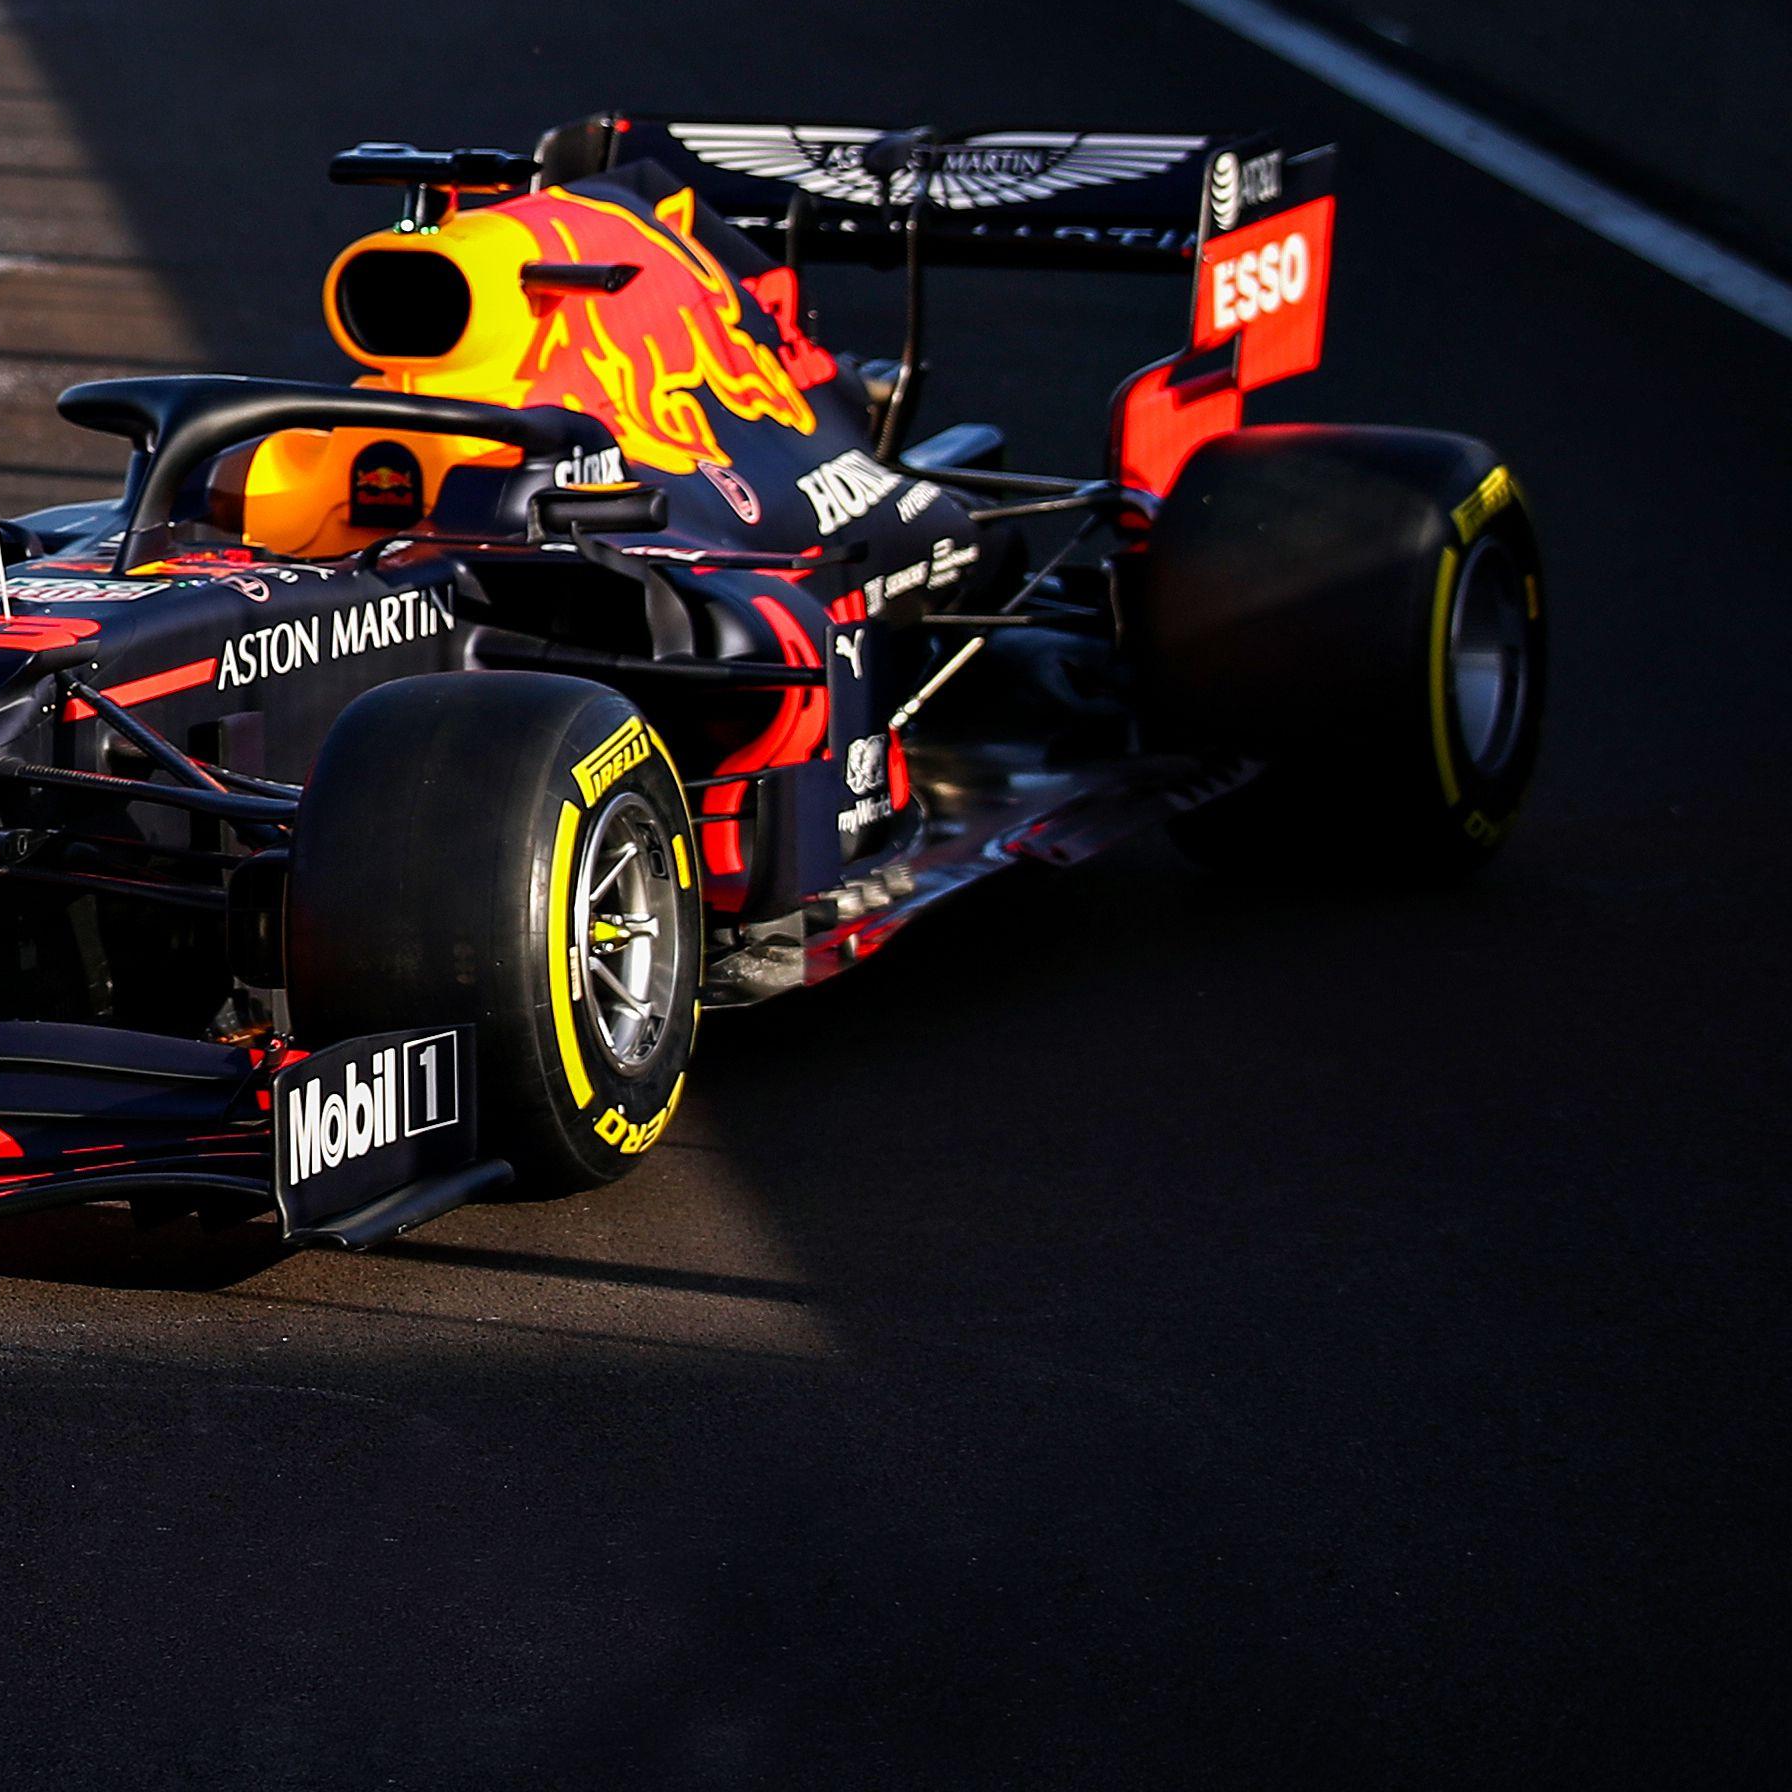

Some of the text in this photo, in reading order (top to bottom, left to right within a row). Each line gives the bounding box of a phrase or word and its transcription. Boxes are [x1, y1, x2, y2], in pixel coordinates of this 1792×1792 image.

[1213, 232, 1307, 330] ESSO
[217, 583, 456, 691] ASTON MARTIN
[570, 715, 652, 809] PIRELLI
[289, 1047, 398, 1186] Mobil
